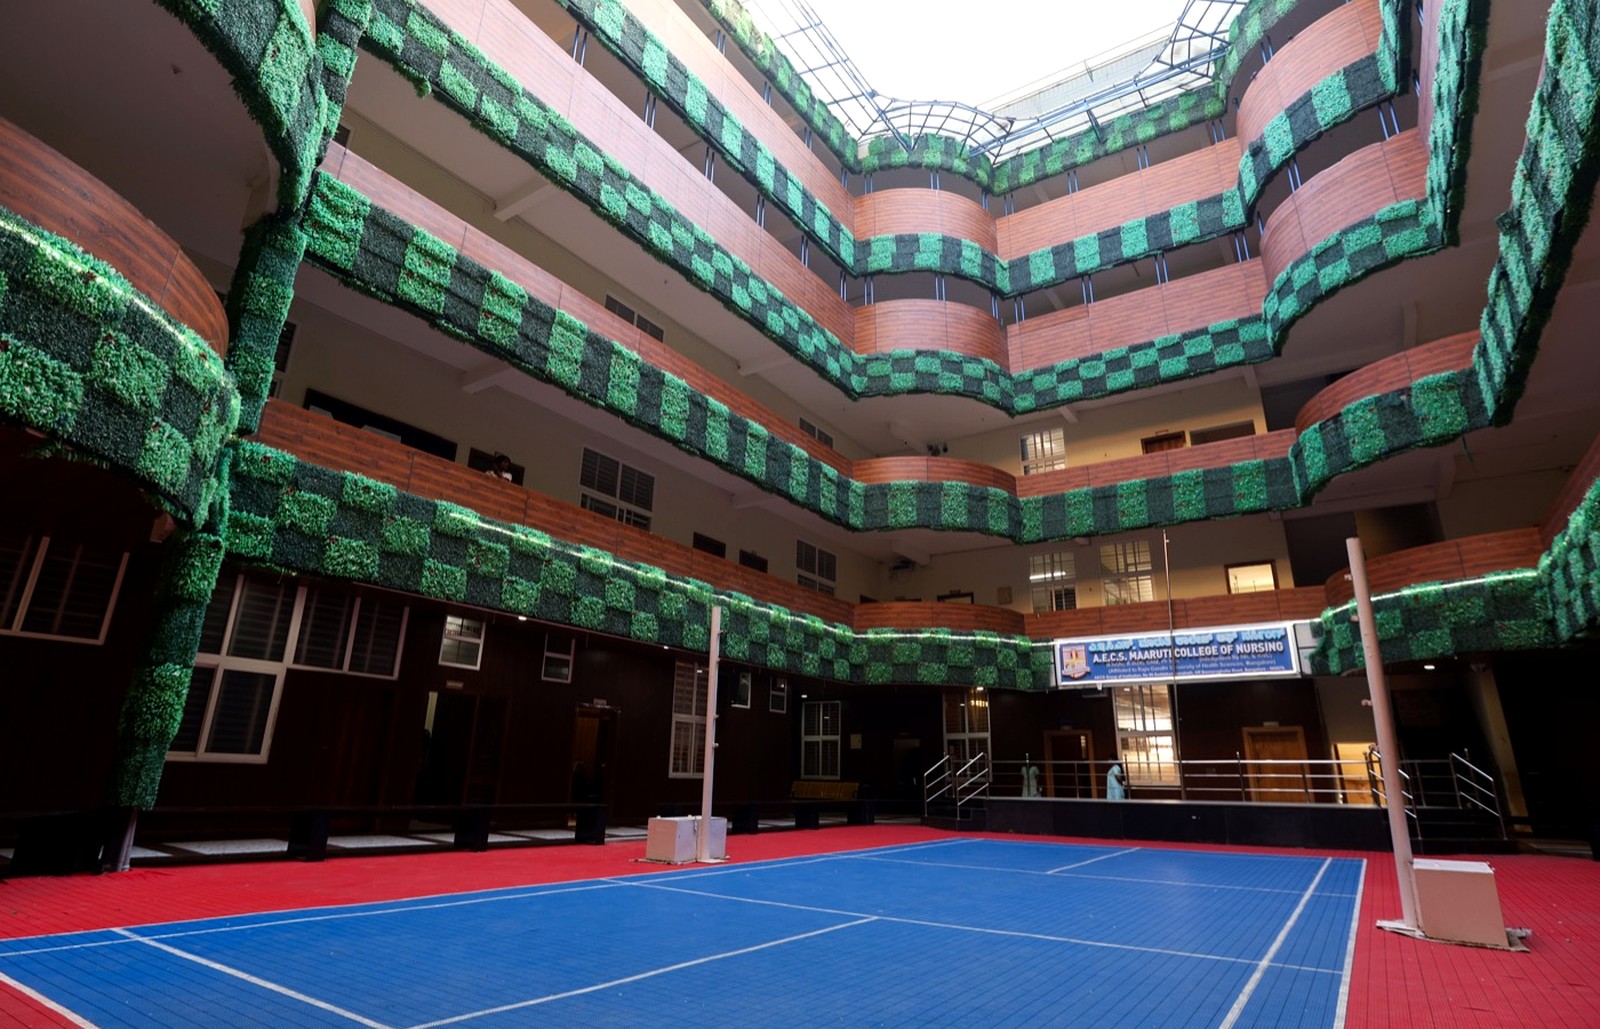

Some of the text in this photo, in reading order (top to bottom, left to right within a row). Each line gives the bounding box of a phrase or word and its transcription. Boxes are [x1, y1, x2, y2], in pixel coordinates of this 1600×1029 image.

[1093, 652, 1127, 663] A.E.C.S.
[1129, 648, 1172, 660] MAARUTI
[1174, 645, 1219, 657] COLLEGE
[1220, 644, 1234, 656] OF
[1236, 641, 1284, 653] NURSING
